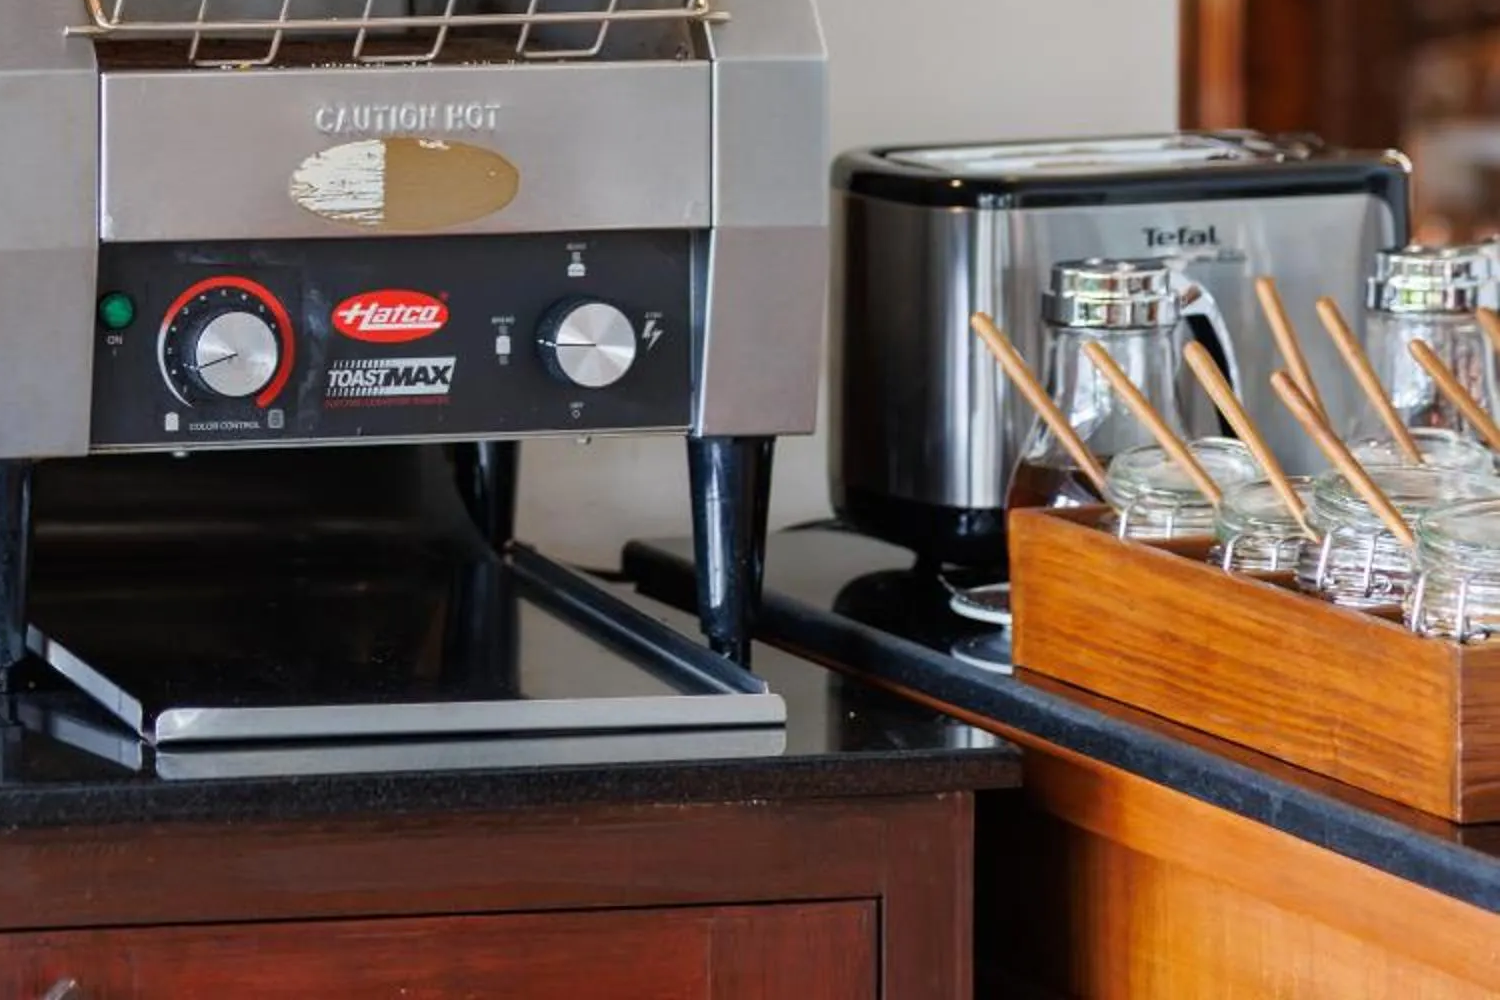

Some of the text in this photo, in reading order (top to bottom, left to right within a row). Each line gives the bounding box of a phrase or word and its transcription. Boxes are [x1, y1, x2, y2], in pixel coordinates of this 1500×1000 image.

[314, 103, 501, 133] CAUTION HOT
[1141, 225, 1220, 247] Tefal
[338, 302, 442, 331] Hatco
